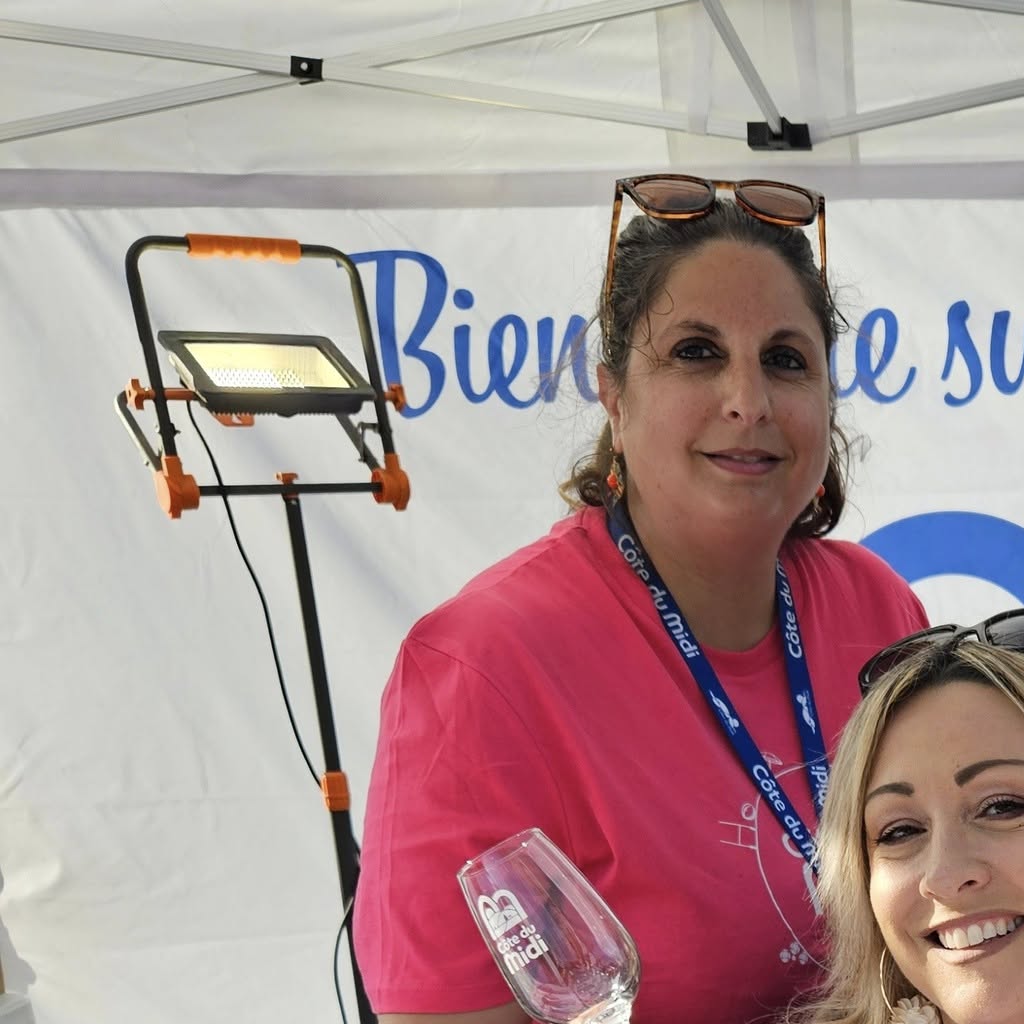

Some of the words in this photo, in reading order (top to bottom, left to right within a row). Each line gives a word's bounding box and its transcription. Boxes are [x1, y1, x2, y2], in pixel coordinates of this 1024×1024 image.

[617, 534, 650, 582] Côte
[650, 585, 668, 612] du
[787, 611, 803, 659] Côte
[752, 764, 786, 811] Côte
[784, 815, 804, 839] du
[497, 935, 520, 955] Côte
[520, 924, 536, 939] du
